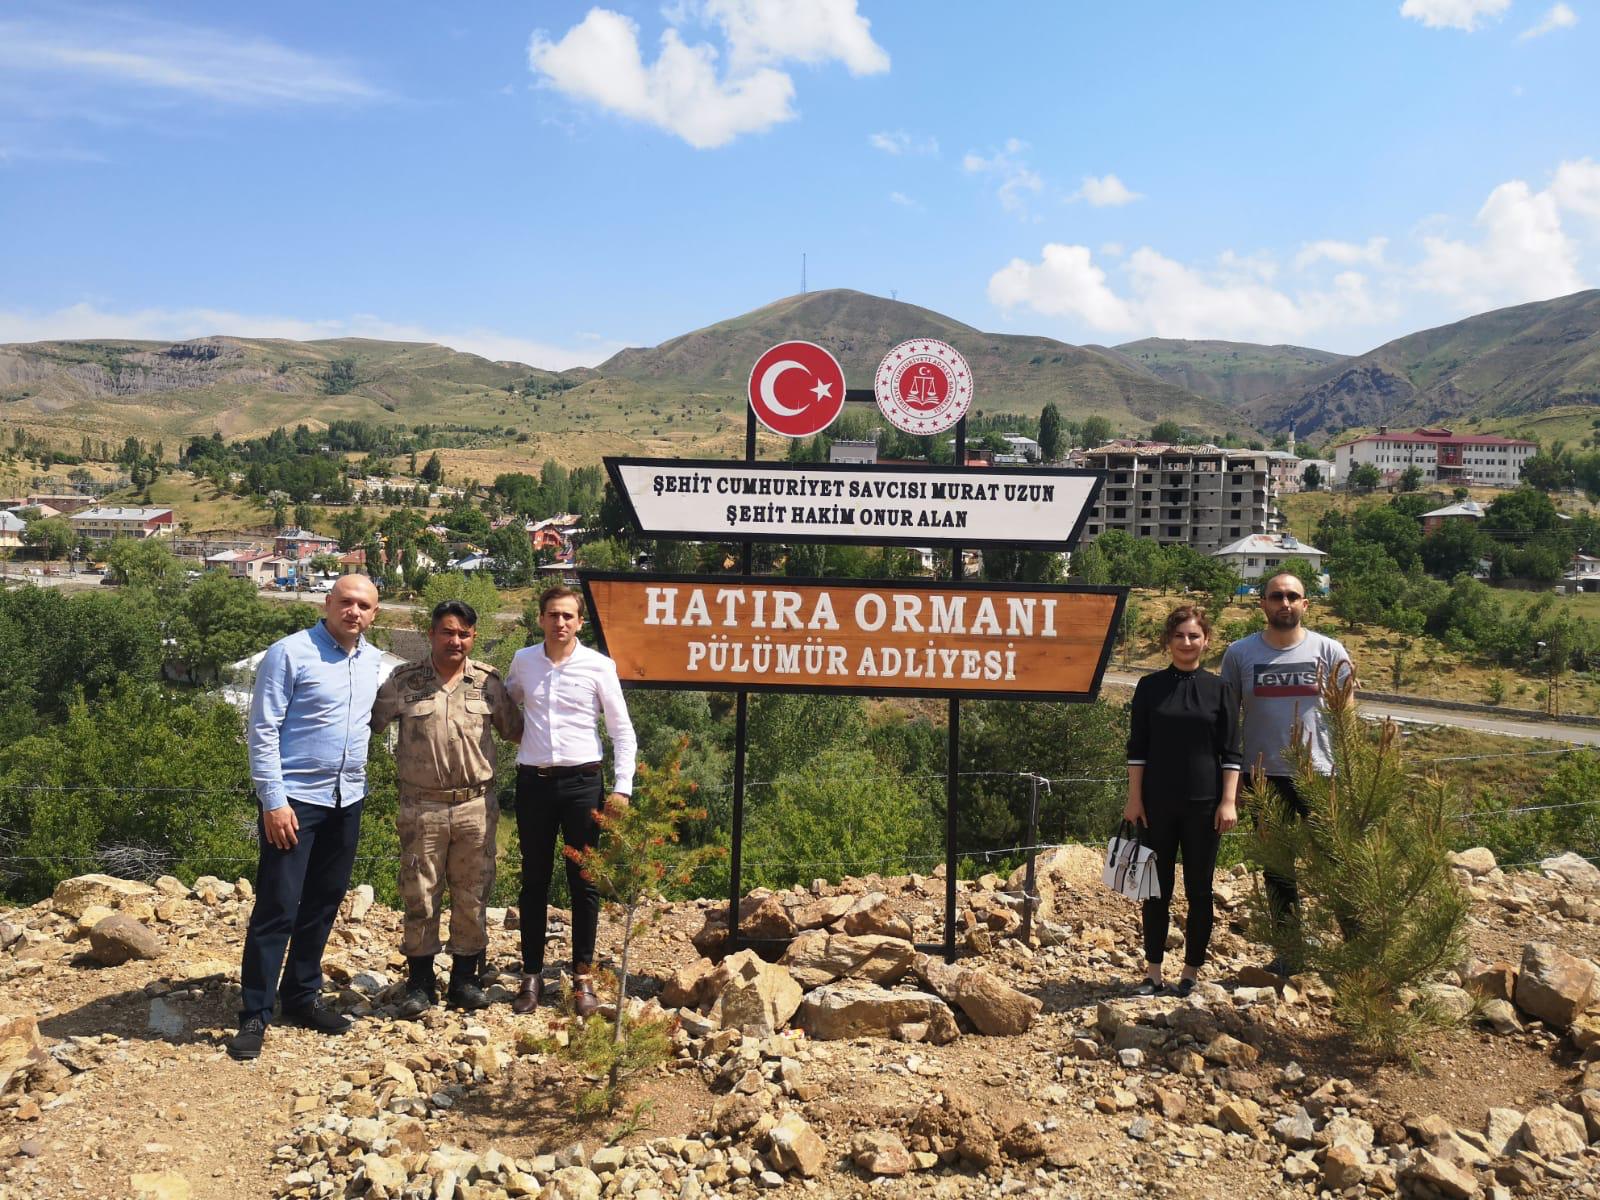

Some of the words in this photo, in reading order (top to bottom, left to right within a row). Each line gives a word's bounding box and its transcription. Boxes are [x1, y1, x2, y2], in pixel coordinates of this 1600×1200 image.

[653, 472, 712, 497] ŞEHİT
[716, 475, 845, 497] CUMHURİYET
[848, 480, 927, 499] SAVCISI
[931, 482, 1000, 501] MURAT
[1004, 484, 1055, 502] UZUN
[726, 502, 787, 526] ŞEHİT
[791, 504, 855, 525] HAKİM
[859, 508, 914, 527] ONUR
[917, 510, 968, 528] ALAN
[643, 587, 840, 630] HATIRA
[854, 592, 1058, 637] ORMANI
[686, 633, 849, 676] PÜLÜMÜR
[856, 639, 1017, 681] ADLİYESİ
